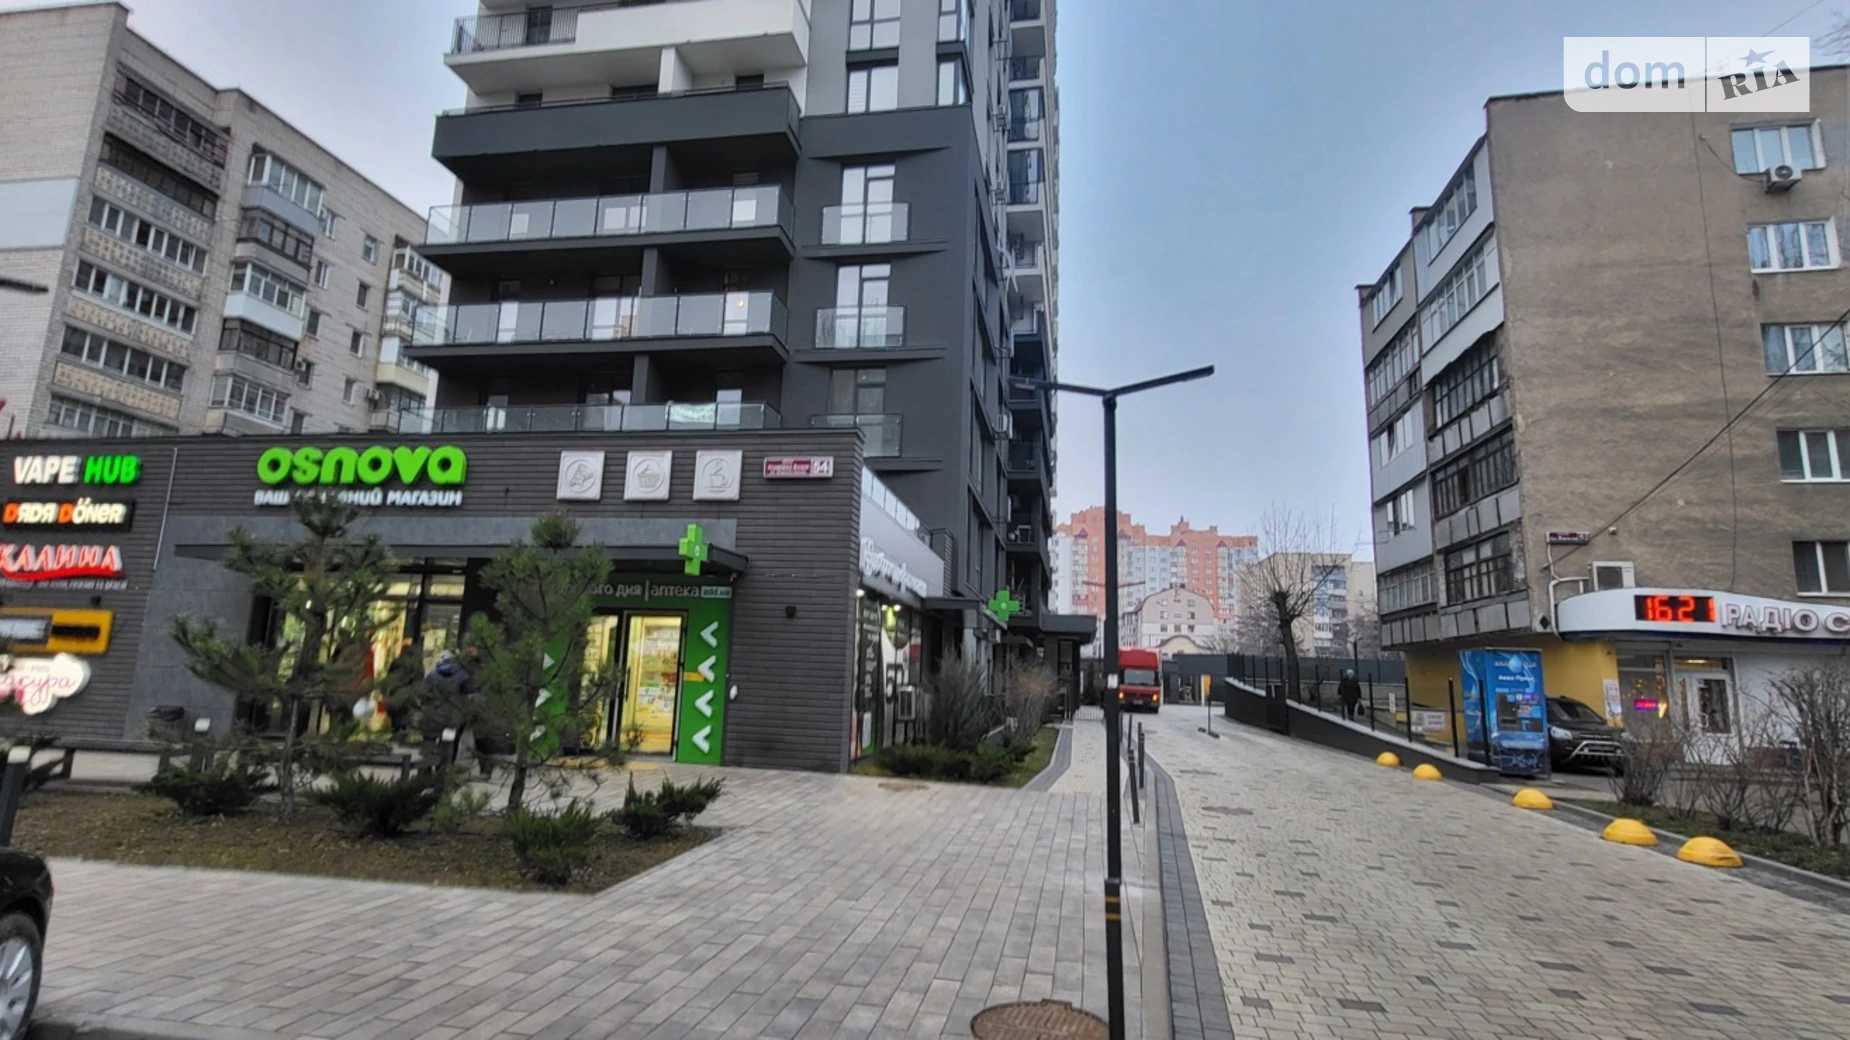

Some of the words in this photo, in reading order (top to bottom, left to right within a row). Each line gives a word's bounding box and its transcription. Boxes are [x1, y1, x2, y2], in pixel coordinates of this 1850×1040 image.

[14, 455, 80, 484] VAPE
[84, 455, 140, 484] HUB
[257, 445, 467, 485] osnova
[386, 489, 463, 505] МАГАЗИН
[0, 543, 122, 572] КАЛИНА
[615, 585, 642, 597] дня
[651, 585, 699, 597] аптека
[1723, 604, 1819, 633] РАДІО
